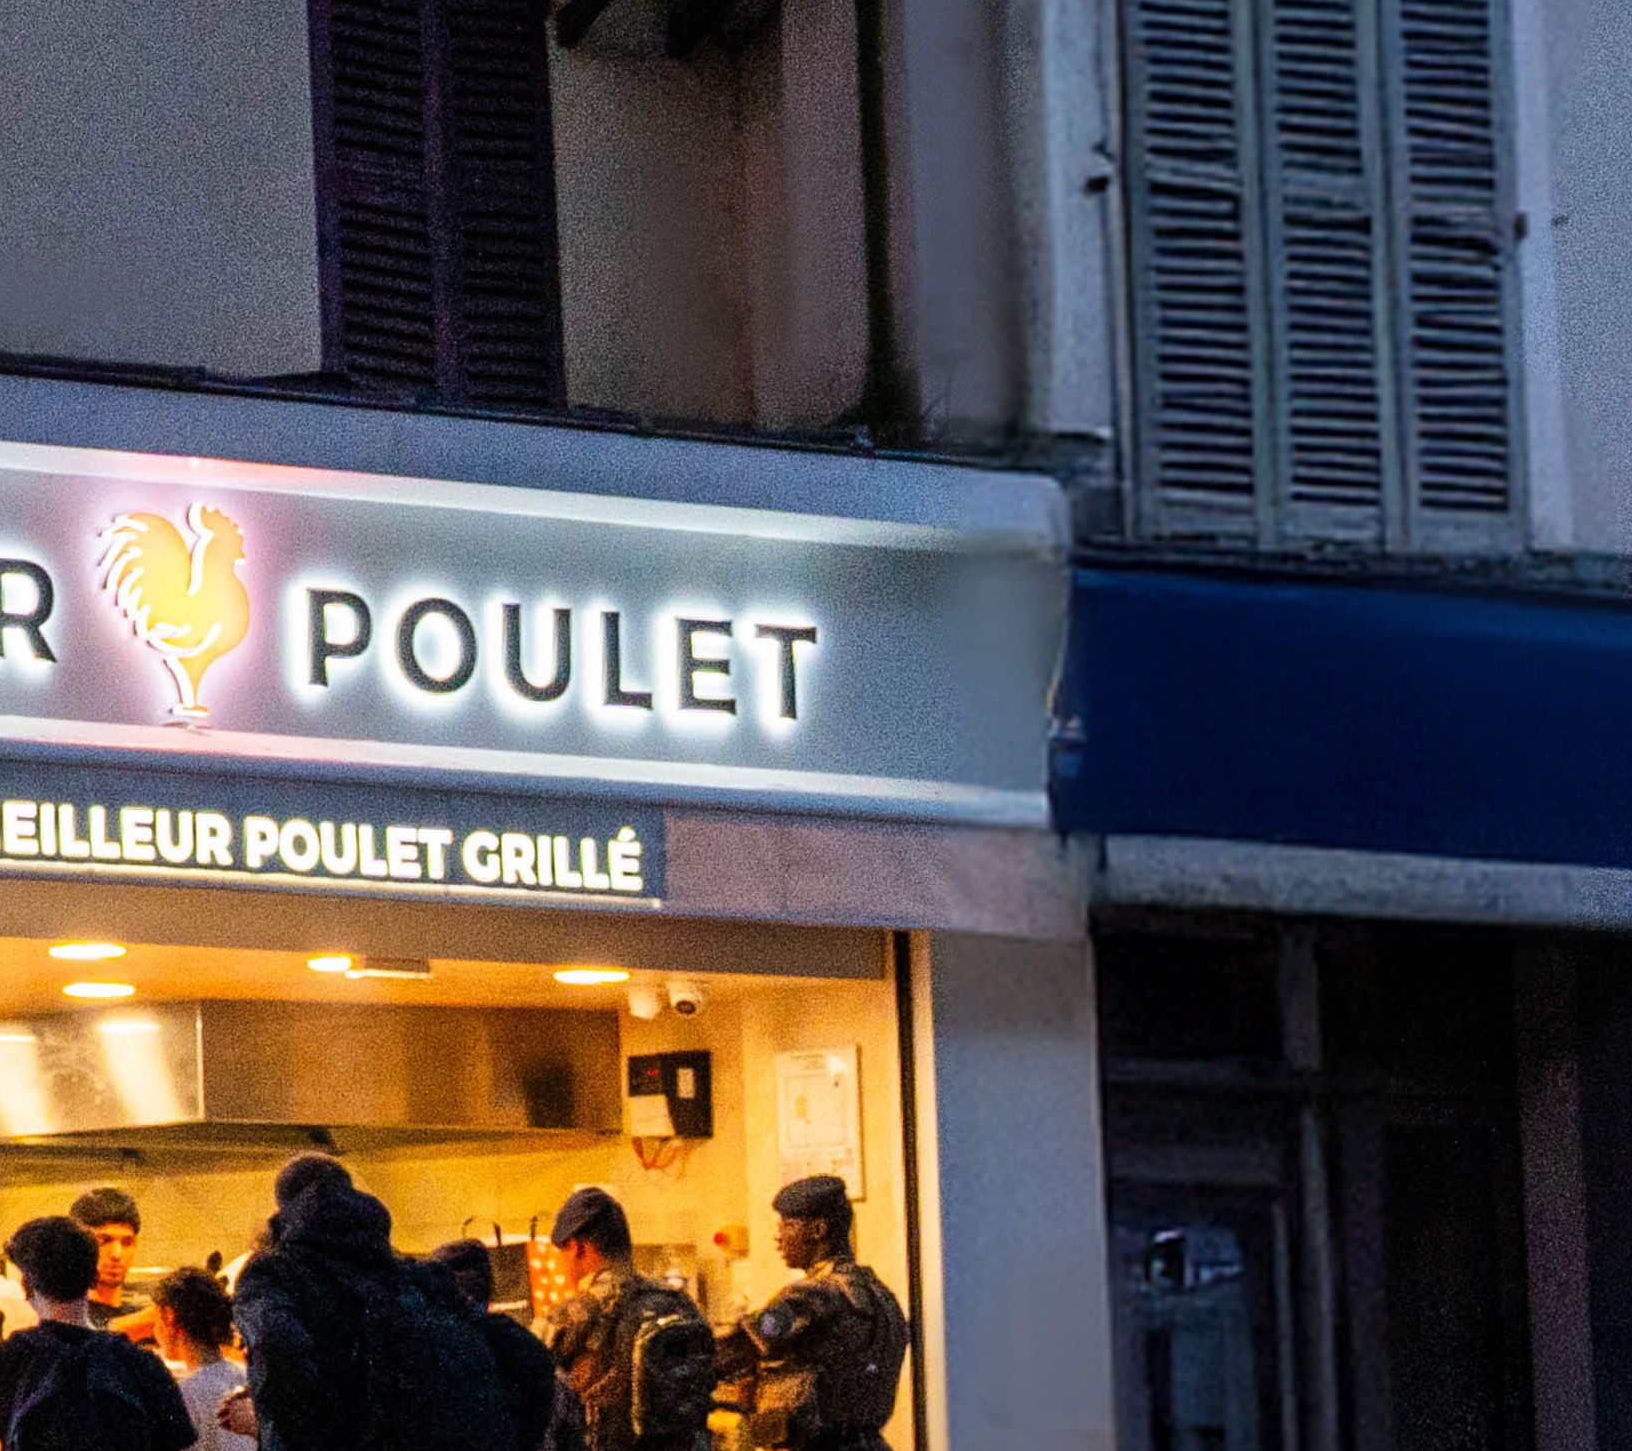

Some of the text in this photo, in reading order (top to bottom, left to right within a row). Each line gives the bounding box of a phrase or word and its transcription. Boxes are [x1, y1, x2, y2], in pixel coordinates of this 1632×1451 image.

[305, 587, 818, 720] POULET
[246, 817, 453, 882] POULET
[462, 825, 646, 893] GRILLÉ
